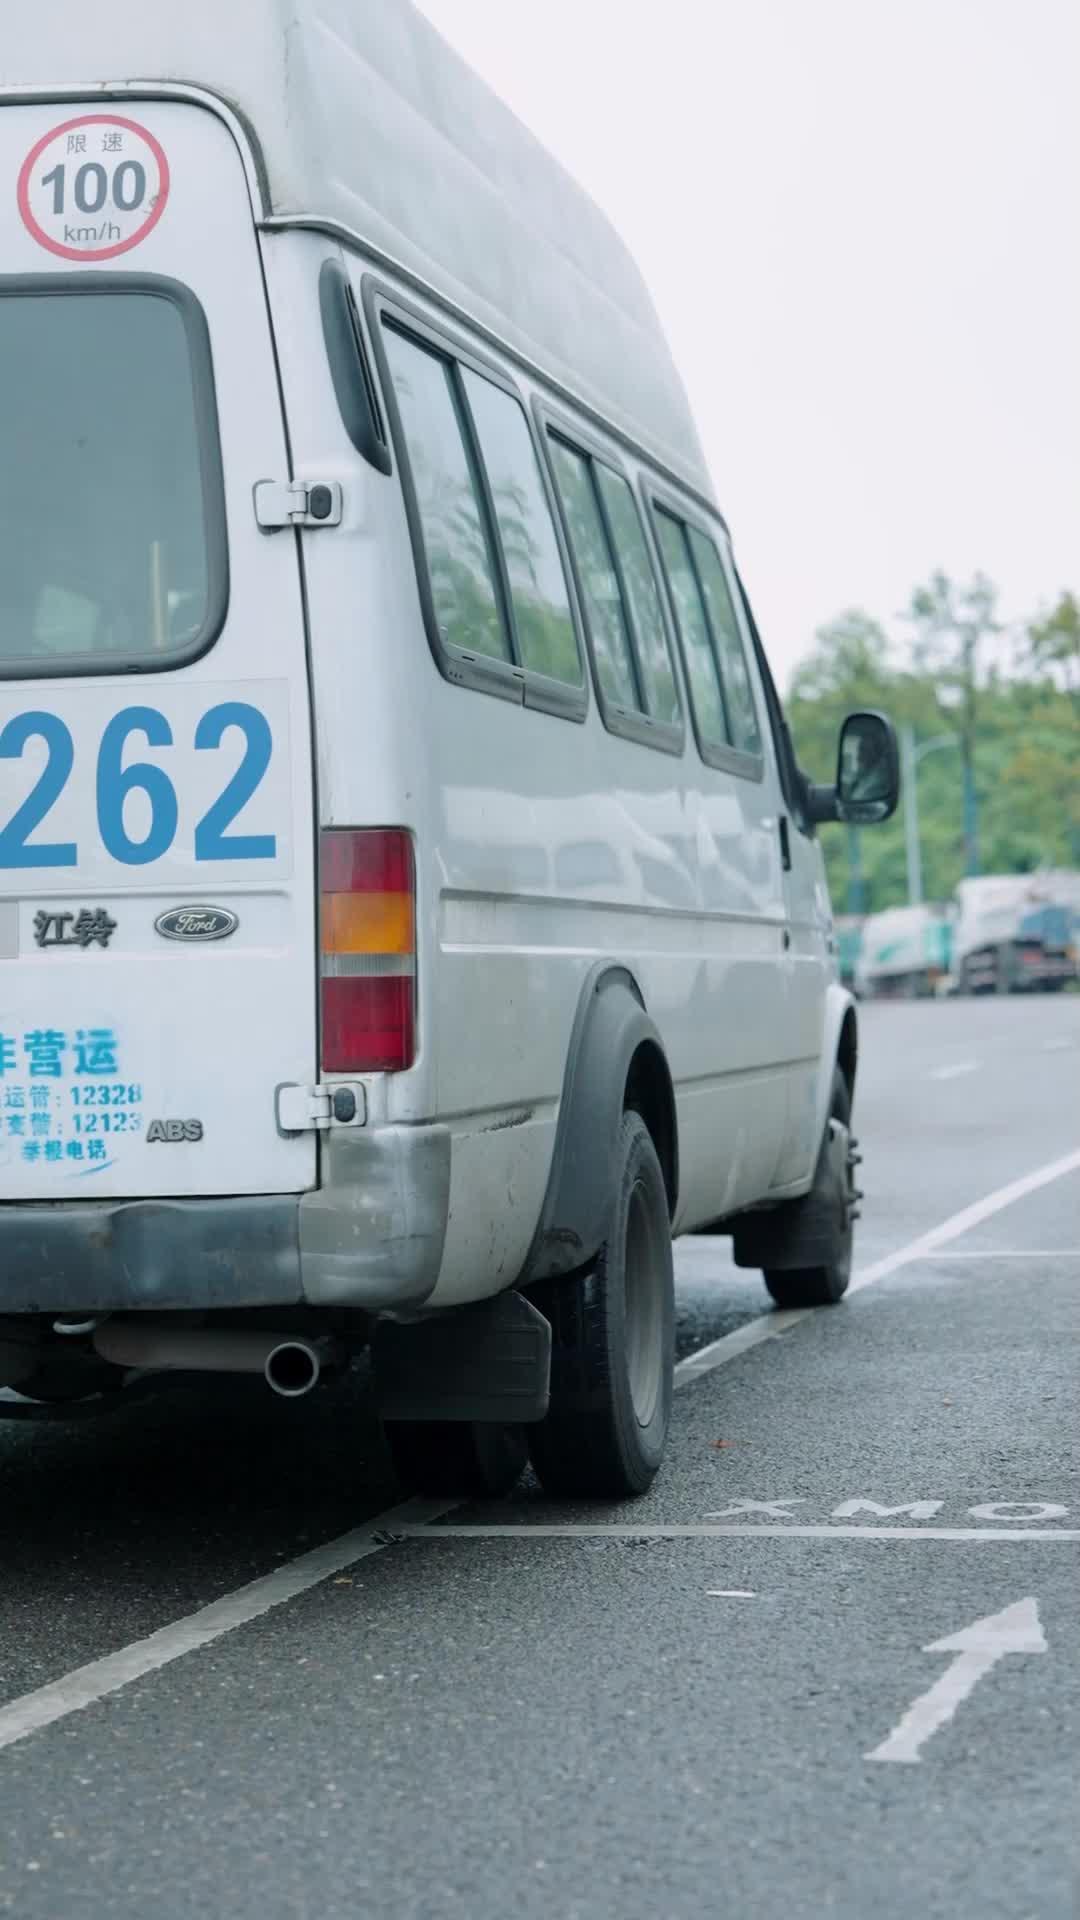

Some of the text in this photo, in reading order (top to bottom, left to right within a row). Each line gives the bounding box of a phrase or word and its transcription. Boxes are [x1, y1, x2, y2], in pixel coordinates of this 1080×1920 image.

[66, 133, 123, 154] 限速
[41, 160, 146, 215] 100
[64, 221, 121, 242] km/h
[0, 702, 276, 869] 262
[33, 907, 117, 948] 江铃
[146, 1119, 204, 1142] ABS
